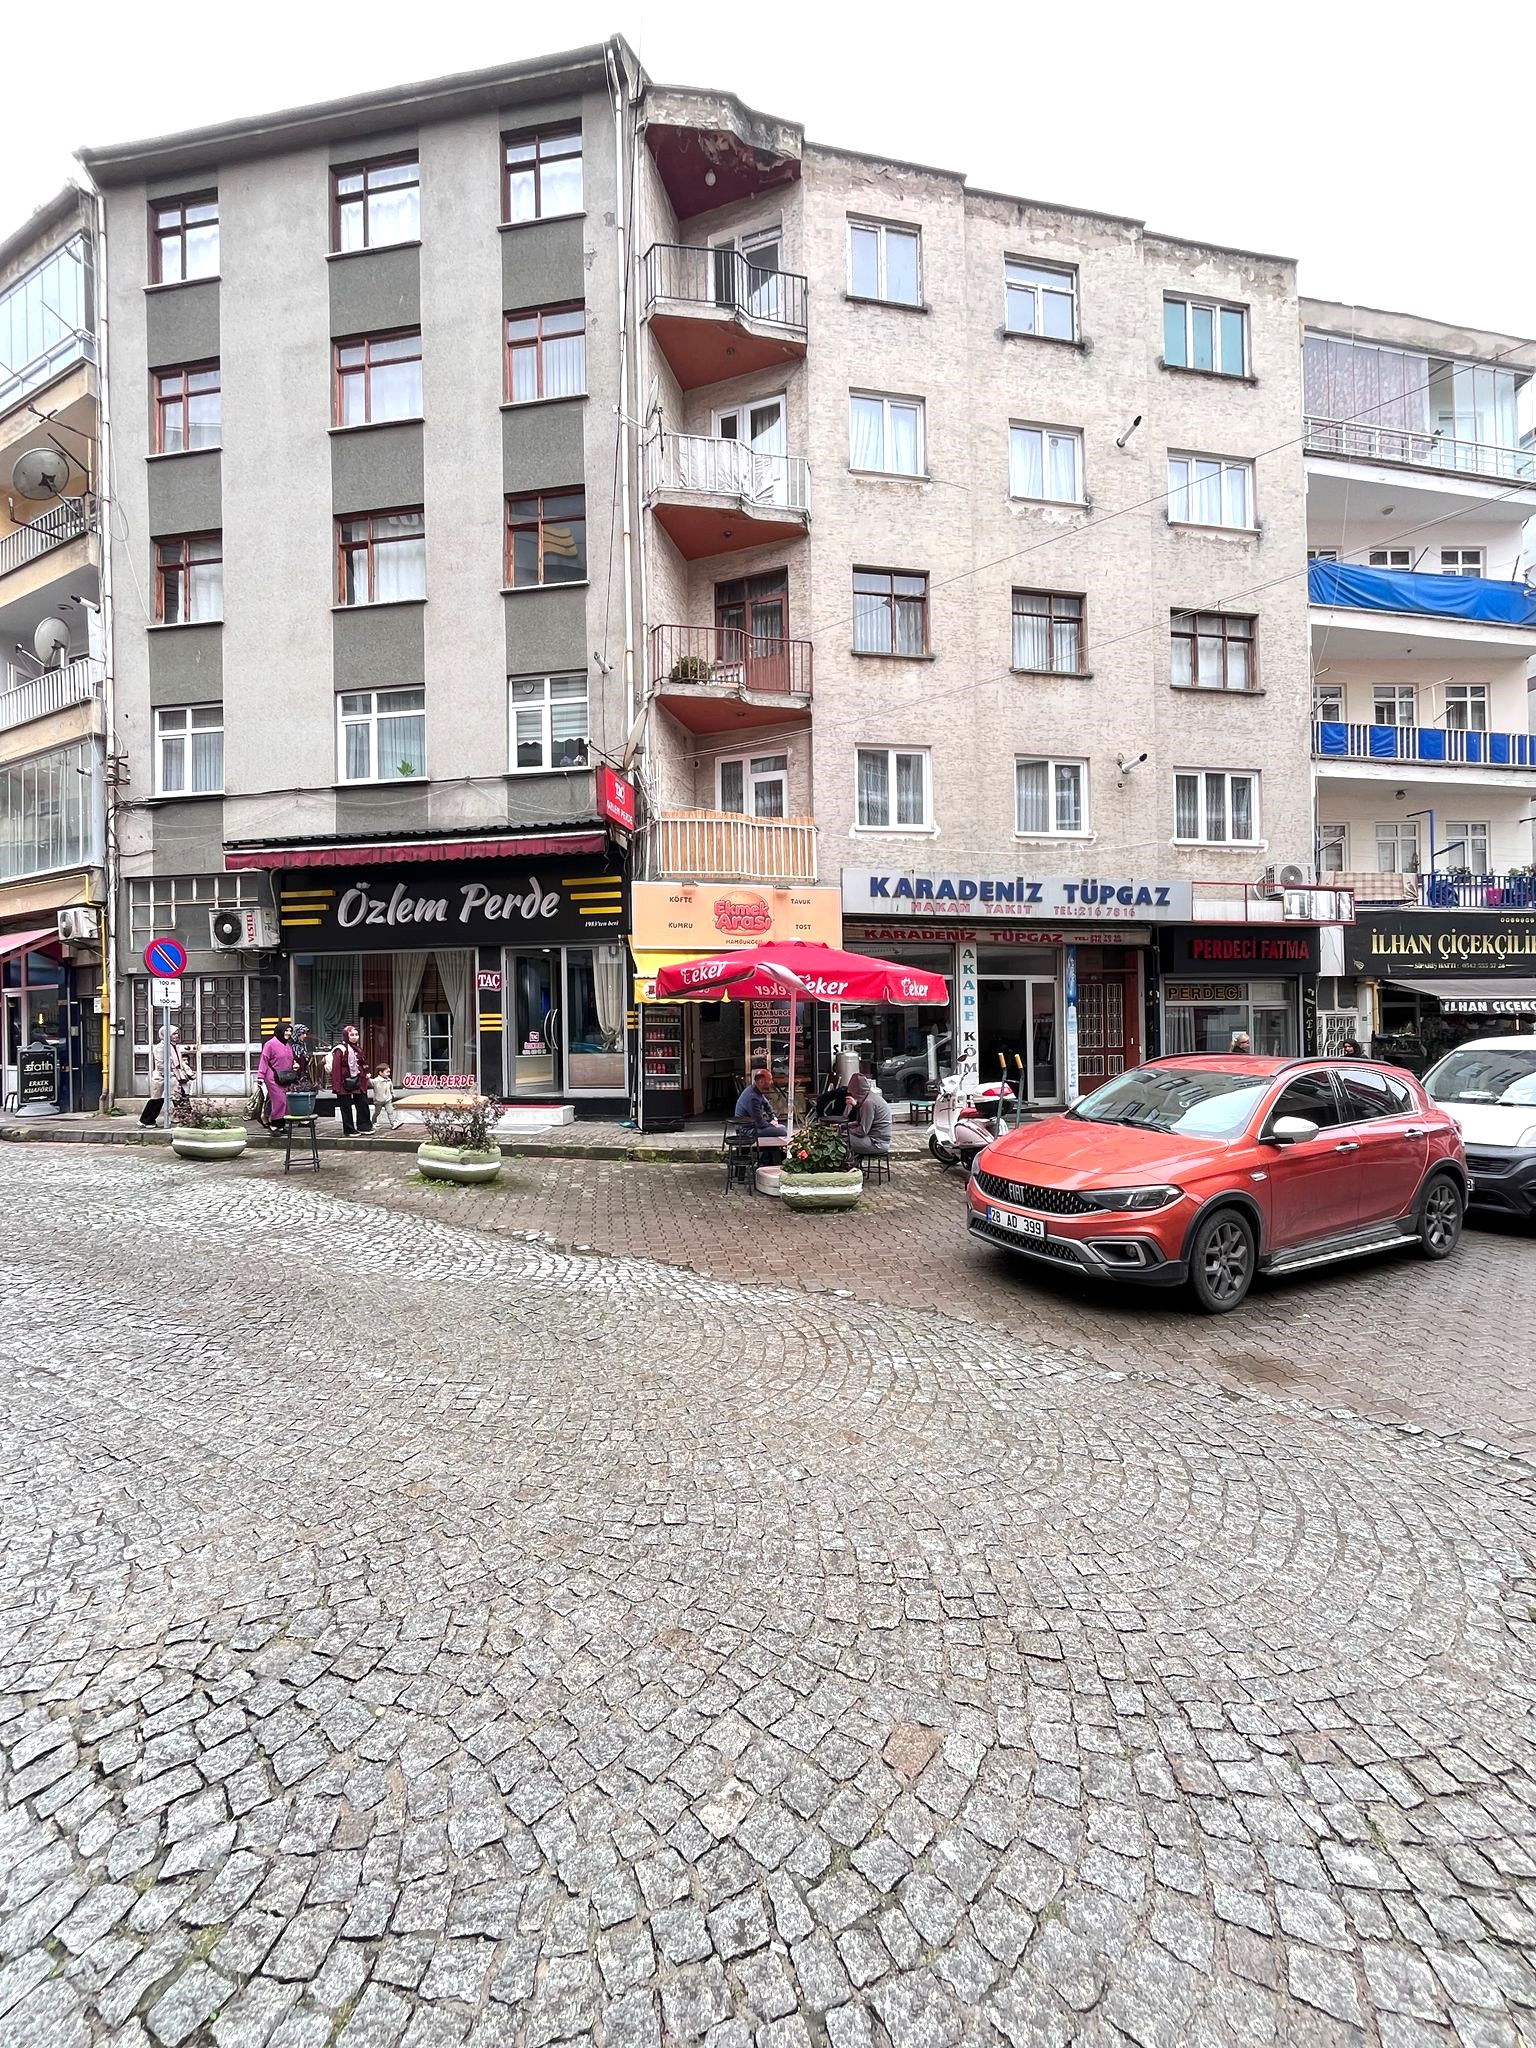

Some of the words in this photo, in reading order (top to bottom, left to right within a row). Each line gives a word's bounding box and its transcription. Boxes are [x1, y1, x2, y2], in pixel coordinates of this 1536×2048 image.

[669, 895, 693, 904] KÖFTE
[870, 876, 1043, 903] KARADENİZ
[1063, 878, 1171, 906] TÜPGAZ
[337, 881, 448, 928] Özlem
[458, 876, 561, 923] Perde
[713, 899, 770, 917] Ekmek
[911, 901, 971, 913] HAKAN
[984, 903, 1033, 915] YAKIT
[246, 911, 255, 943] VESTEL
[714, 913, 772, 931] Arası
[864, 927, 977, 942] KARADENİZ
[990, 929, 1063, 943] TÜPGAZ
[1371, 928, 1433, 955] İLHAN
[1192, 936, 1257, 960] PERDECİ
[1261, 939, 1310, 960] FATMA
[478, 974, 501, 989] TAÇ
[753, 1009, 792, 1017] HAMBURGE
[1444, 1001, 1488, 1013] İLHAN
[753, 1018, 780, 1026] KUMRU
[753, 1026, 778, 1035] SUCUK
[403, 1072, 437, 1088] ÖZLEM
[440, 1074, 476, 1087] PERDE
[1008, 1182, 1025, 1202] FIAT
[992, 1210, 1001, 1222] 28
[1007, 1215, 1017, 1228] AD
[1024, 1219, 1041, 1234] 399
